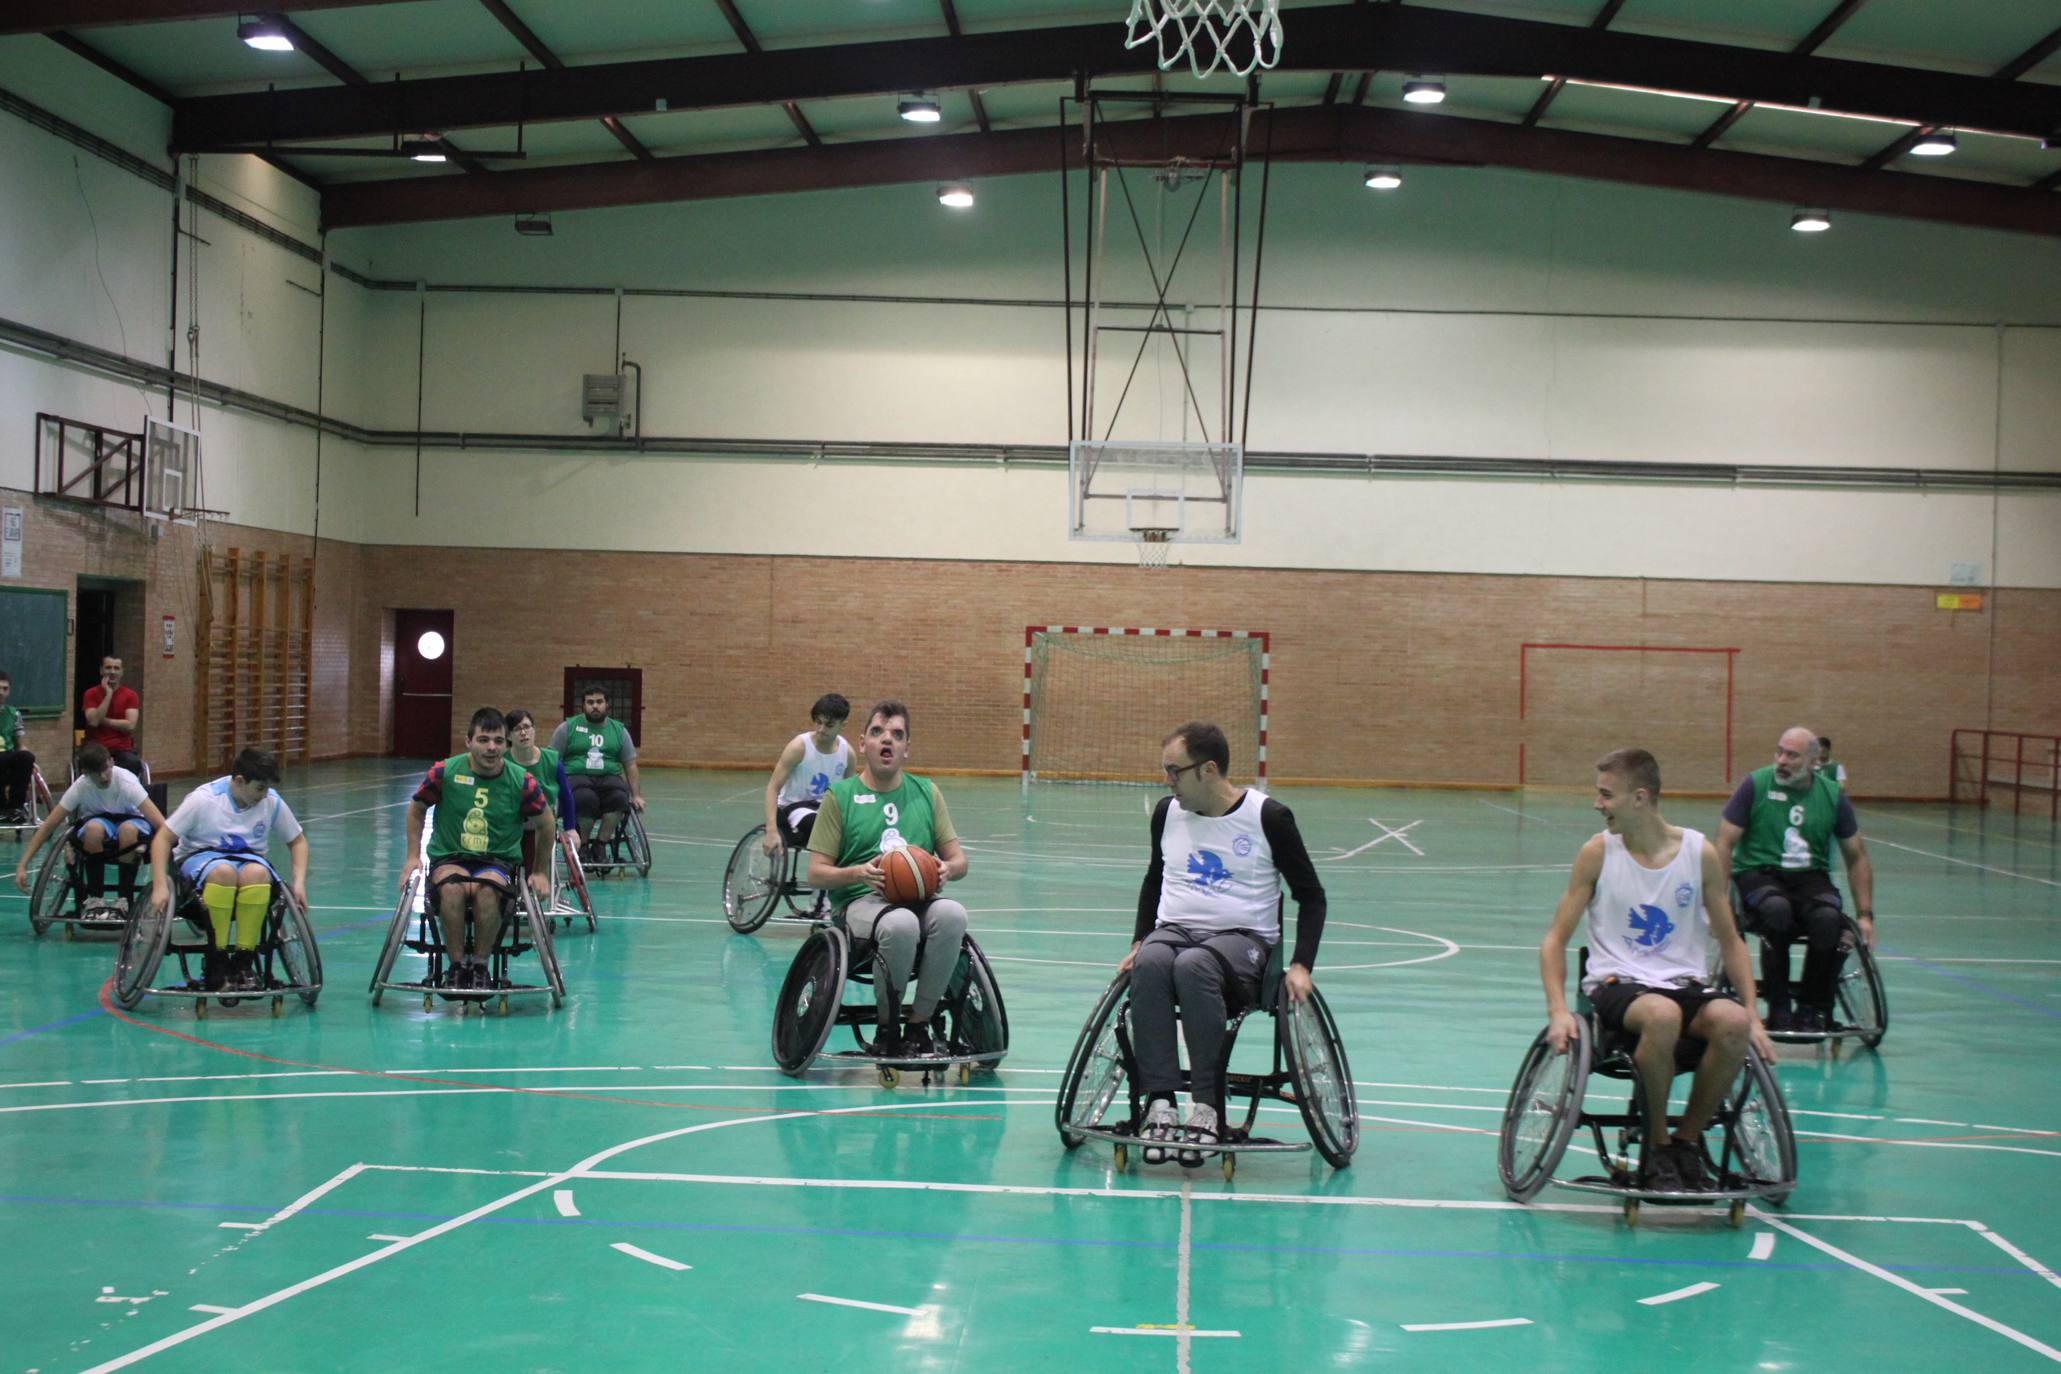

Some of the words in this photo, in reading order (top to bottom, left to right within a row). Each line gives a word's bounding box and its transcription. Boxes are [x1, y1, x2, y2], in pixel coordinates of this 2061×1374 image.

[588, 734, 604, 747] 10
[474, 787, 489, 808] 5
[883, 802, 899, 825] 9
[1789, 804, 1805, 826] 6
